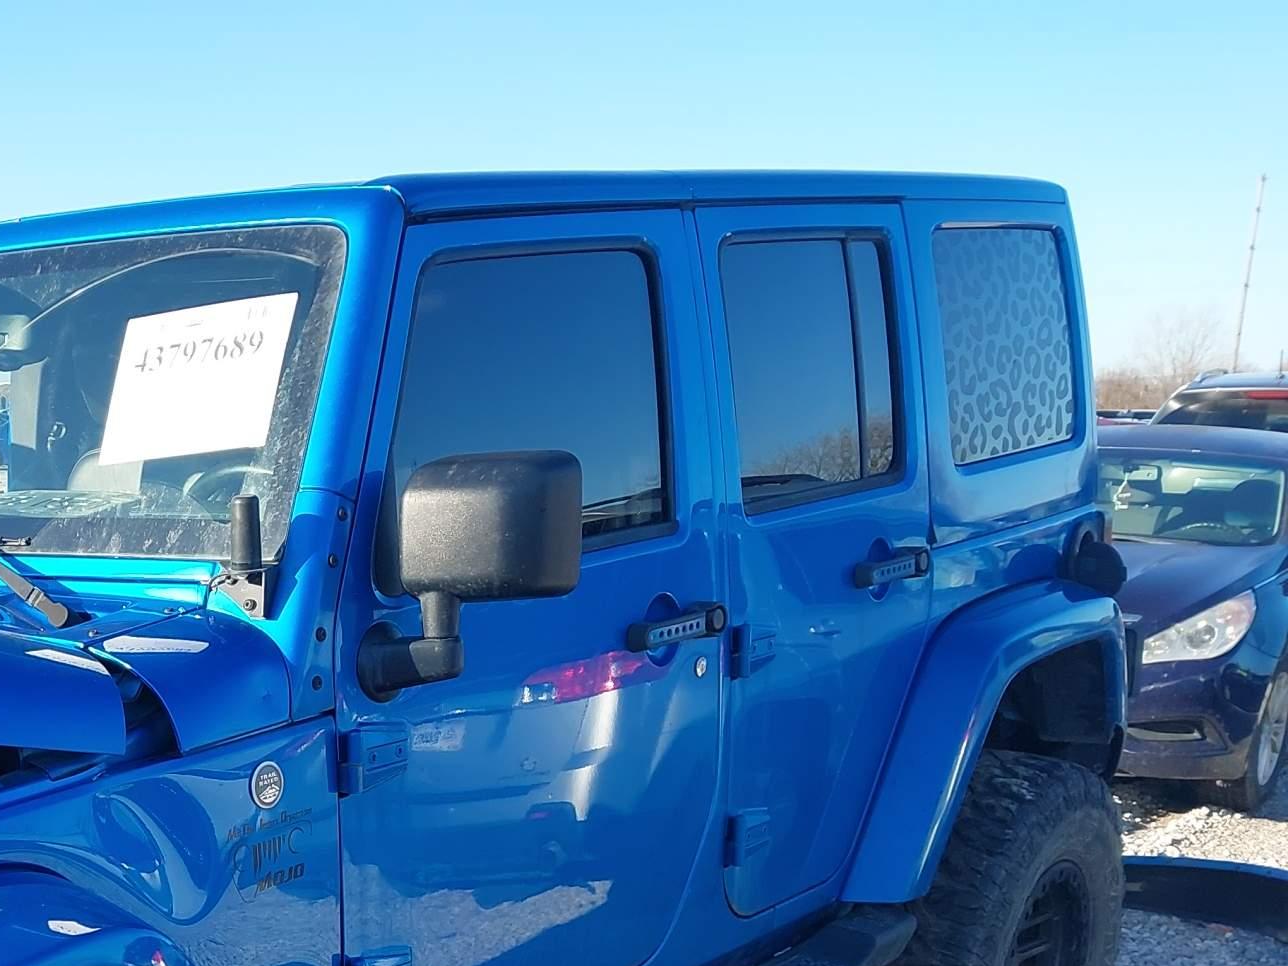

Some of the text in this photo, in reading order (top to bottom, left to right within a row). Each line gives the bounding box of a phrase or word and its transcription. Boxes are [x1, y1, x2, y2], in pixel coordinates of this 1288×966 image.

[135, 330, 265, 373] 43797689
[260, 771, 277, 780] TRAIL
[258, 776, 279, 787] RATED
